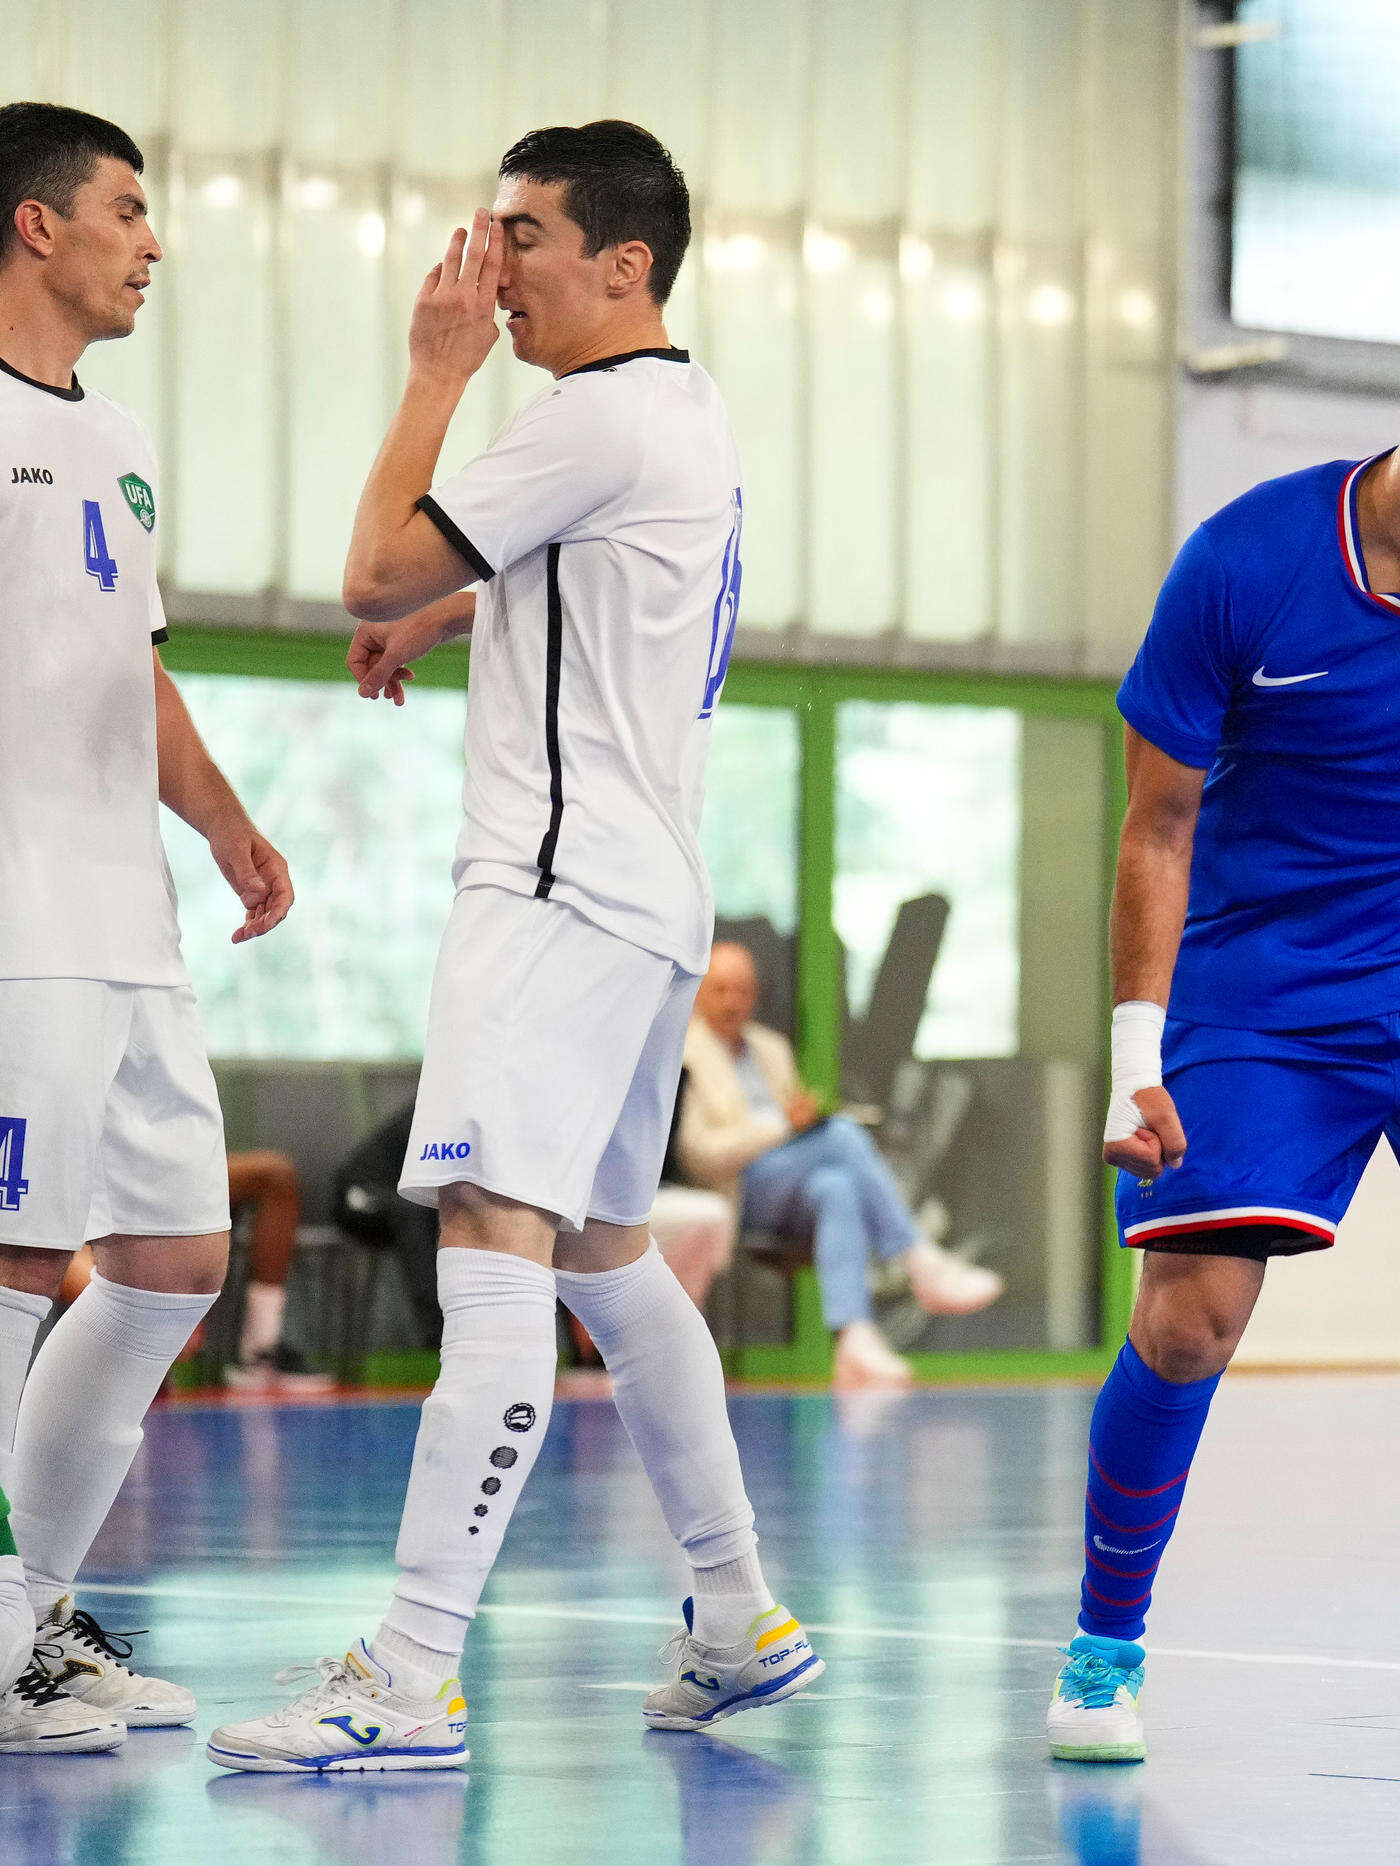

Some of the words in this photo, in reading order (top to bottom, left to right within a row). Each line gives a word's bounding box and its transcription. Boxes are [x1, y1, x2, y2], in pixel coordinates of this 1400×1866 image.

[11, 467, 54, 485] JAKO
[125, 483, 153, 509] UFA
[82, 499, 119, 592] 4
[0, 1116, 29, 1211] 4
[420, 1142, 471, 1161] JAKO
